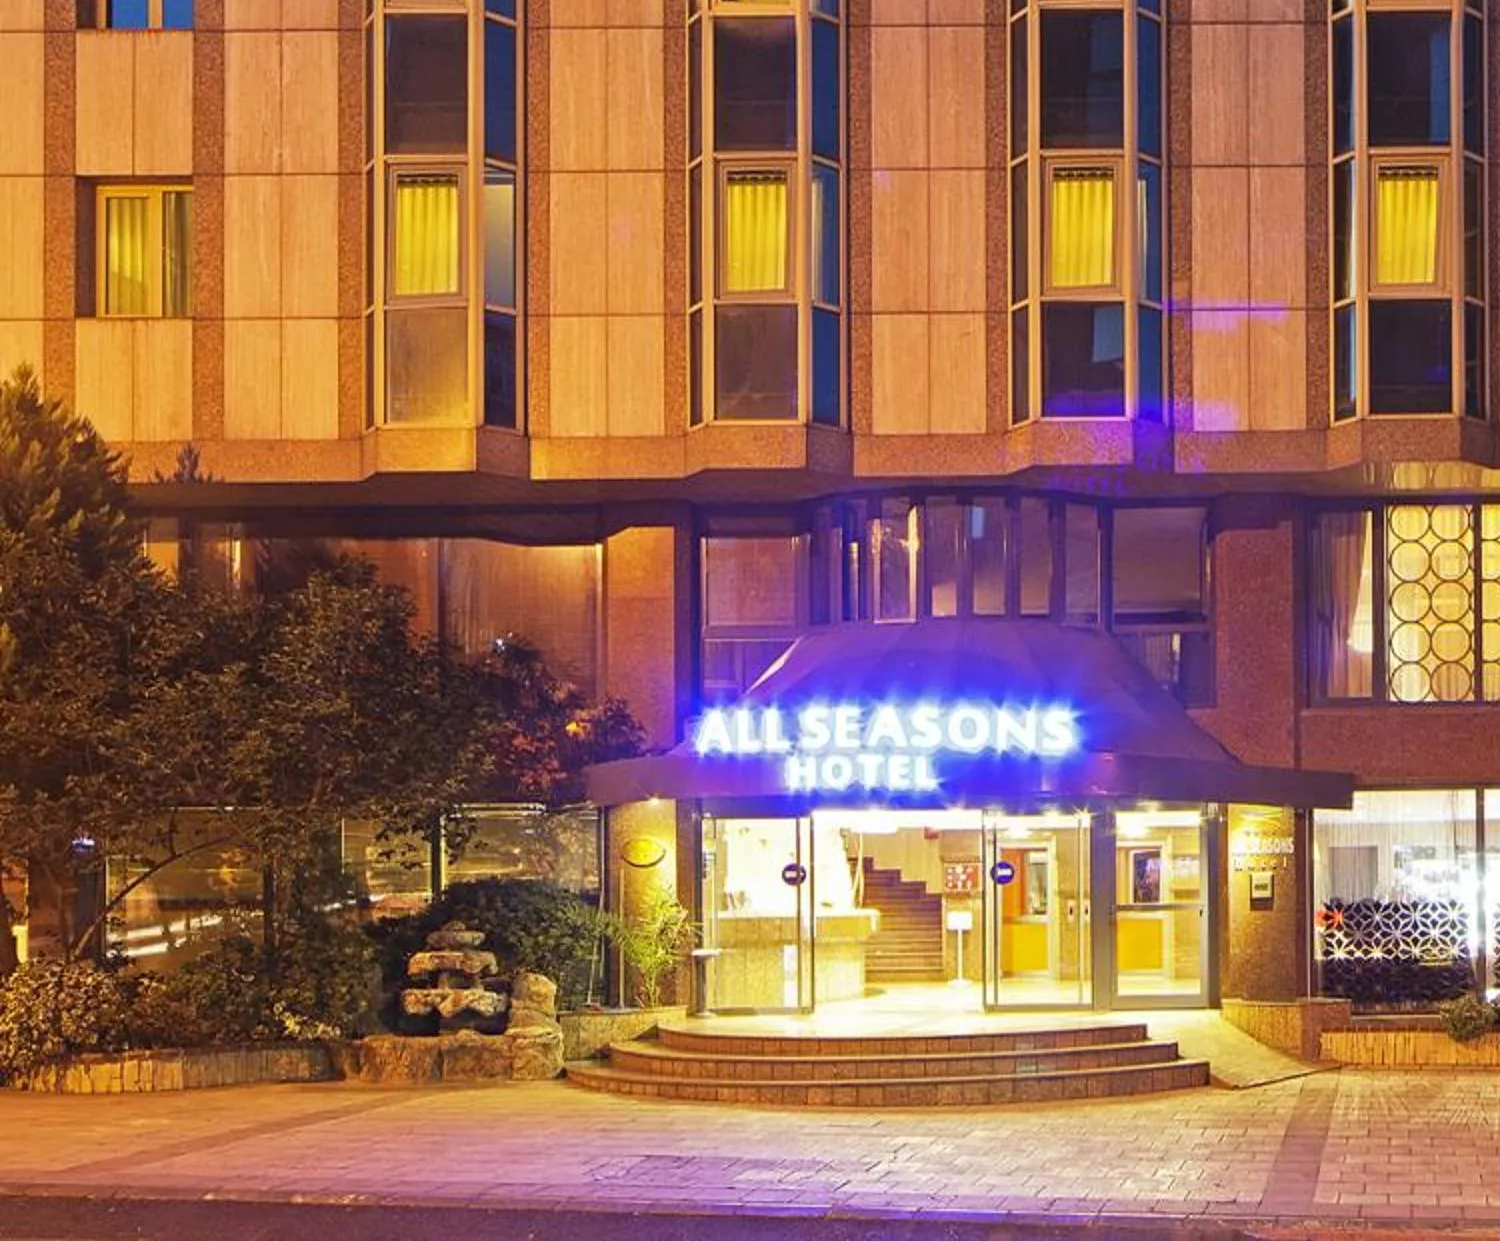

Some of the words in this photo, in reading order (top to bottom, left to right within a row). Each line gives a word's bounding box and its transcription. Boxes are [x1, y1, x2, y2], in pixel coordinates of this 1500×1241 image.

[697, 705, 791, 753] ALL
[801, 704, 1076, 754] SEASONS
[786, 756, 938, 791] HOTEL
